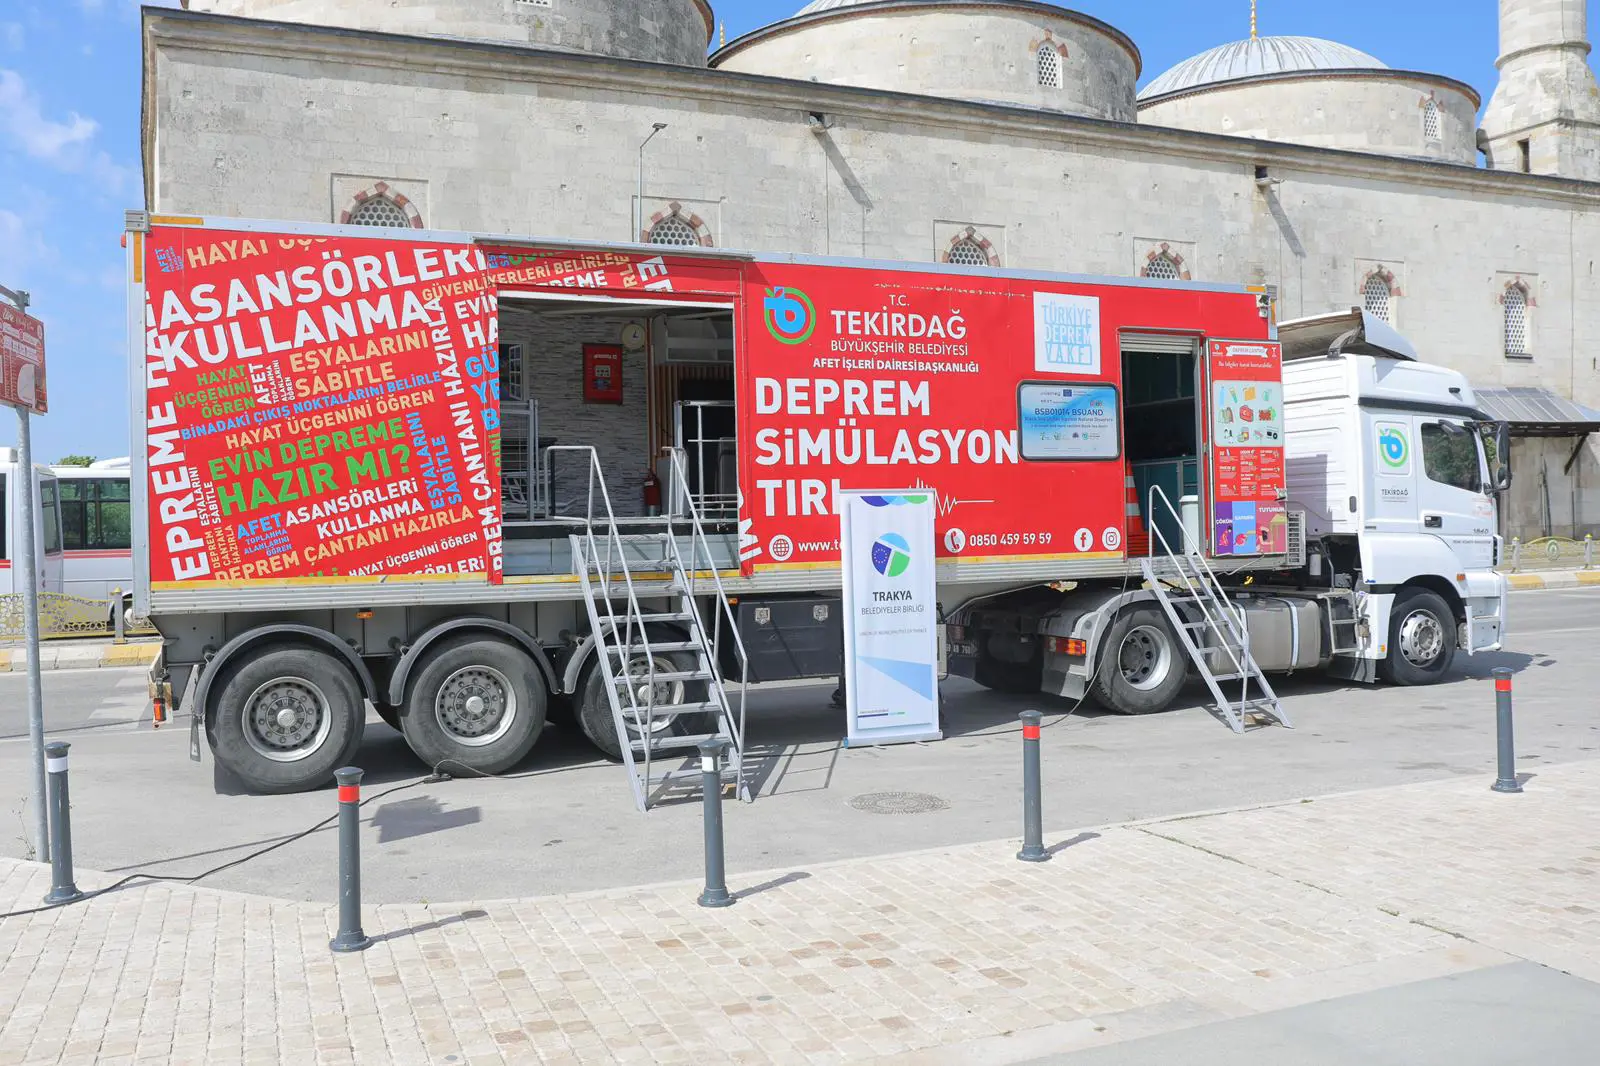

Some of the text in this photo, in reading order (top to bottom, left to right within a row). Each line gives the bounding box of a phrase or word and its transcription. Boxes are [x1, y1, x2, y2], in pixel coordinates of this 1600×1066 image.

[422, 272, 488, 301] GÜVENLİ
[888, 294, 910, 307] T.C.
[158, 290, 432, 372] KULLANMA
[830, 305, 968, 340] TEKİRDAĞ
[289, 329, 429, 373] EŞYALARINI
[424, 297, 465, 397] HAZIRLA
[813, 356, 980, 374] AFET İŞLERİ DAİRESİ BAŞKANLIĞI
[830, 337, 968, 356] BÜYÜKŞEHİR BELEDİYESİ
[174, 377, 252, 408] ÜÇGENİNİ
[196, 365, 246, 387] HAYAT
[248, 363, 273, 405] AFET
[295, 361, 396, 398] SABİTLE
[180, 370, 442, 441] BİNADAKİ ÇIKIŞ NOKTALARINI BELİRLE
[201, 396, 256, 419] ÖĞREN
[755, 377, 930, 416] DEPREM
[225, 389, 436, 450] HAYAT ÜÇGENİNİ ÖĞREN
[208, 417, 406, 481] EVİN DEPREME
[405, 411, 446, 510] EŞYALARINI
[450, 400, 497, 501] ÇANTANI
[217, 443, 411, 516] HAZIR MI?
[431, 434, 463, 505] SABİTLE
[203, 481, 222, 524] SABİTLE
[1381, 487, 1409, 496] TEKİRDAĞ
[237, 512, 282, 540] AFET
[245, 528, 288, 545] TOPLANMA
[316, 497, 425, 540] KULLANMA
[204, 531, 221, 569] DEPREM
[213, 505, 474, 581] DEPREM ÇANTANI HAZIRLA
[213, 526, 232, 567] ÇANTANI
[225, 524, 242, 565] HAZIRLA
[349, 560, 385, 576] HAYAT
[386, 541, 440, 567] ÜÇGENİNİ
[441, 531, 479, 551] ÖĞREN
[969, 532, 1052, 547] 0850 459 59 59
[861, 605, 902, 616] BELEDİYELER
[872, 590, 912, 602] TRAKYA
